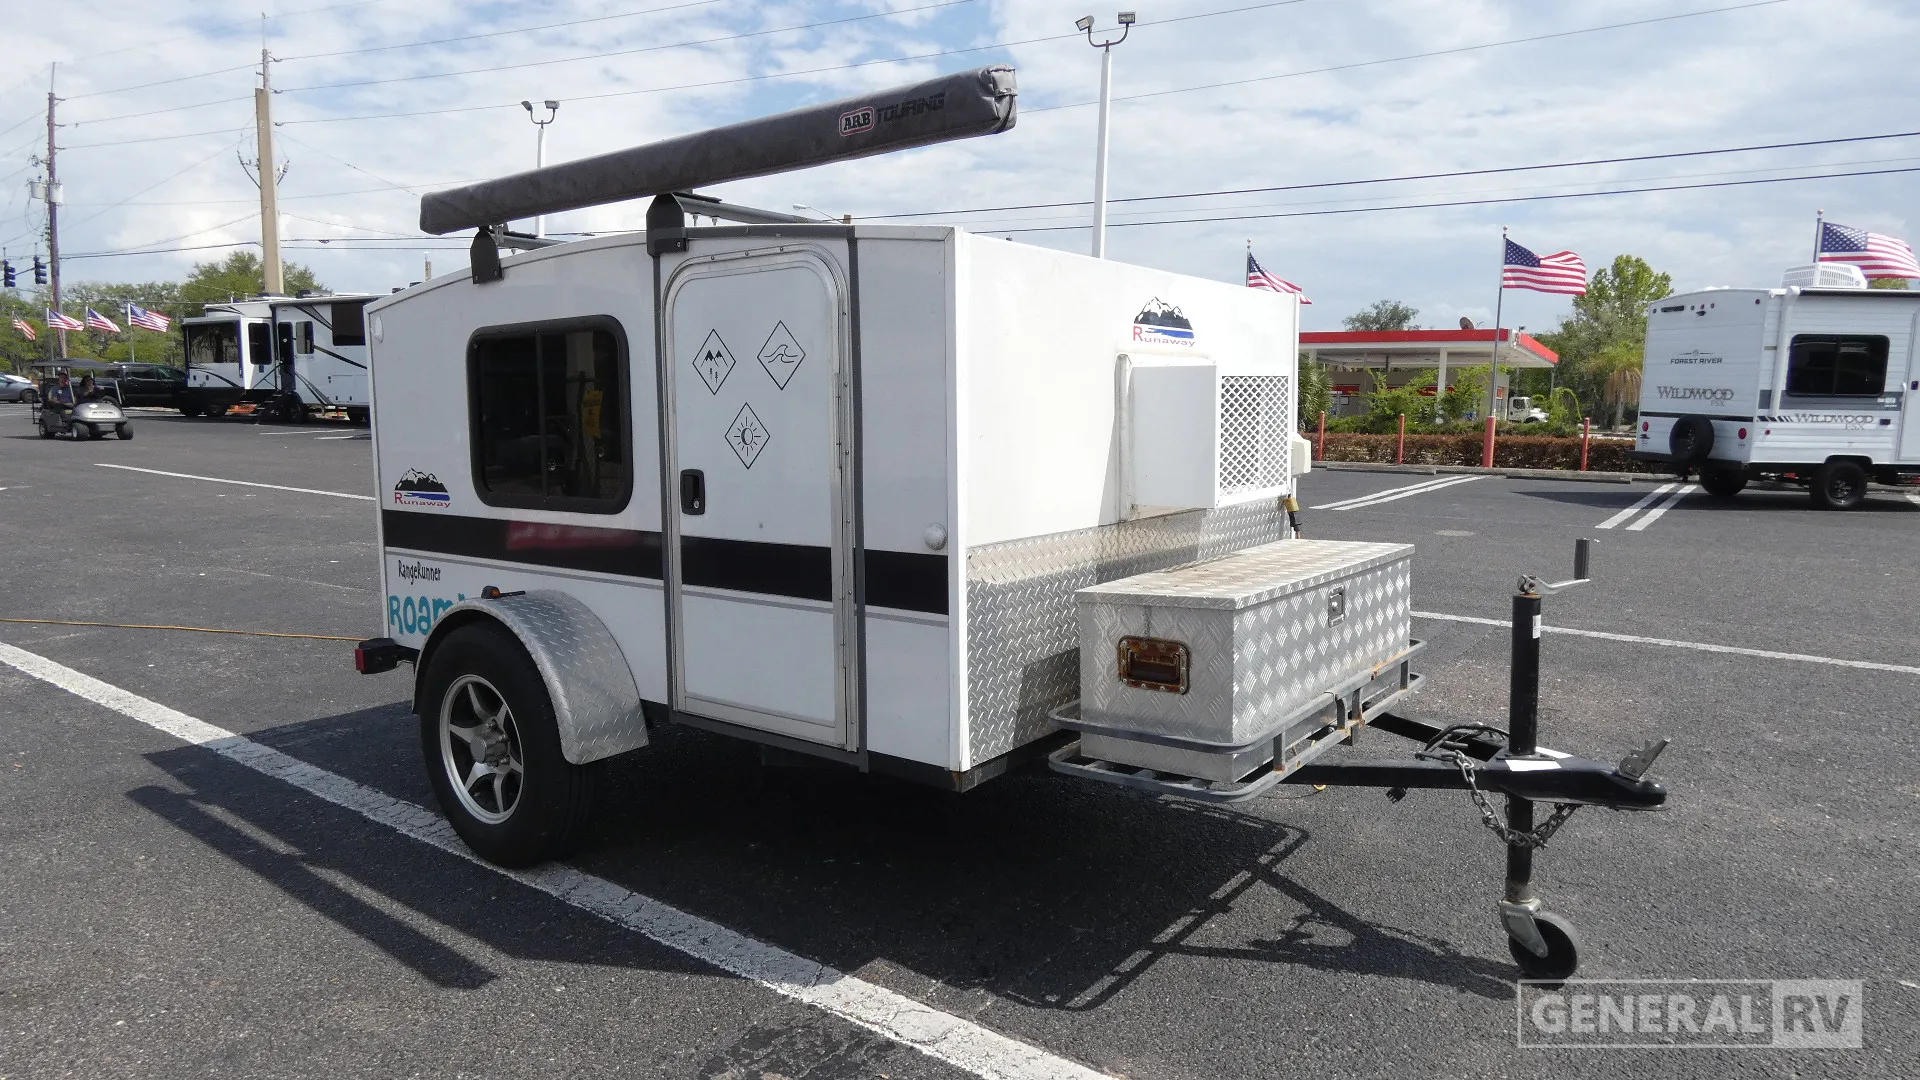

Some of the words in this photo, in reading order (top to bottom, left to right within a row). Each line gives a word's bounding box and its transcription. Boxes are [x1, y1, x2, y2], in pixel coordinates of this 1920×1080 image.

[843, 112, 871, 131] ARB
[877, 92, 946, 123] TOURING
[1133, 325, 1196, 347] Runaway
[394, 491, 451, 508] Runaway
[398, 559, 441, 585] RangeRunner
